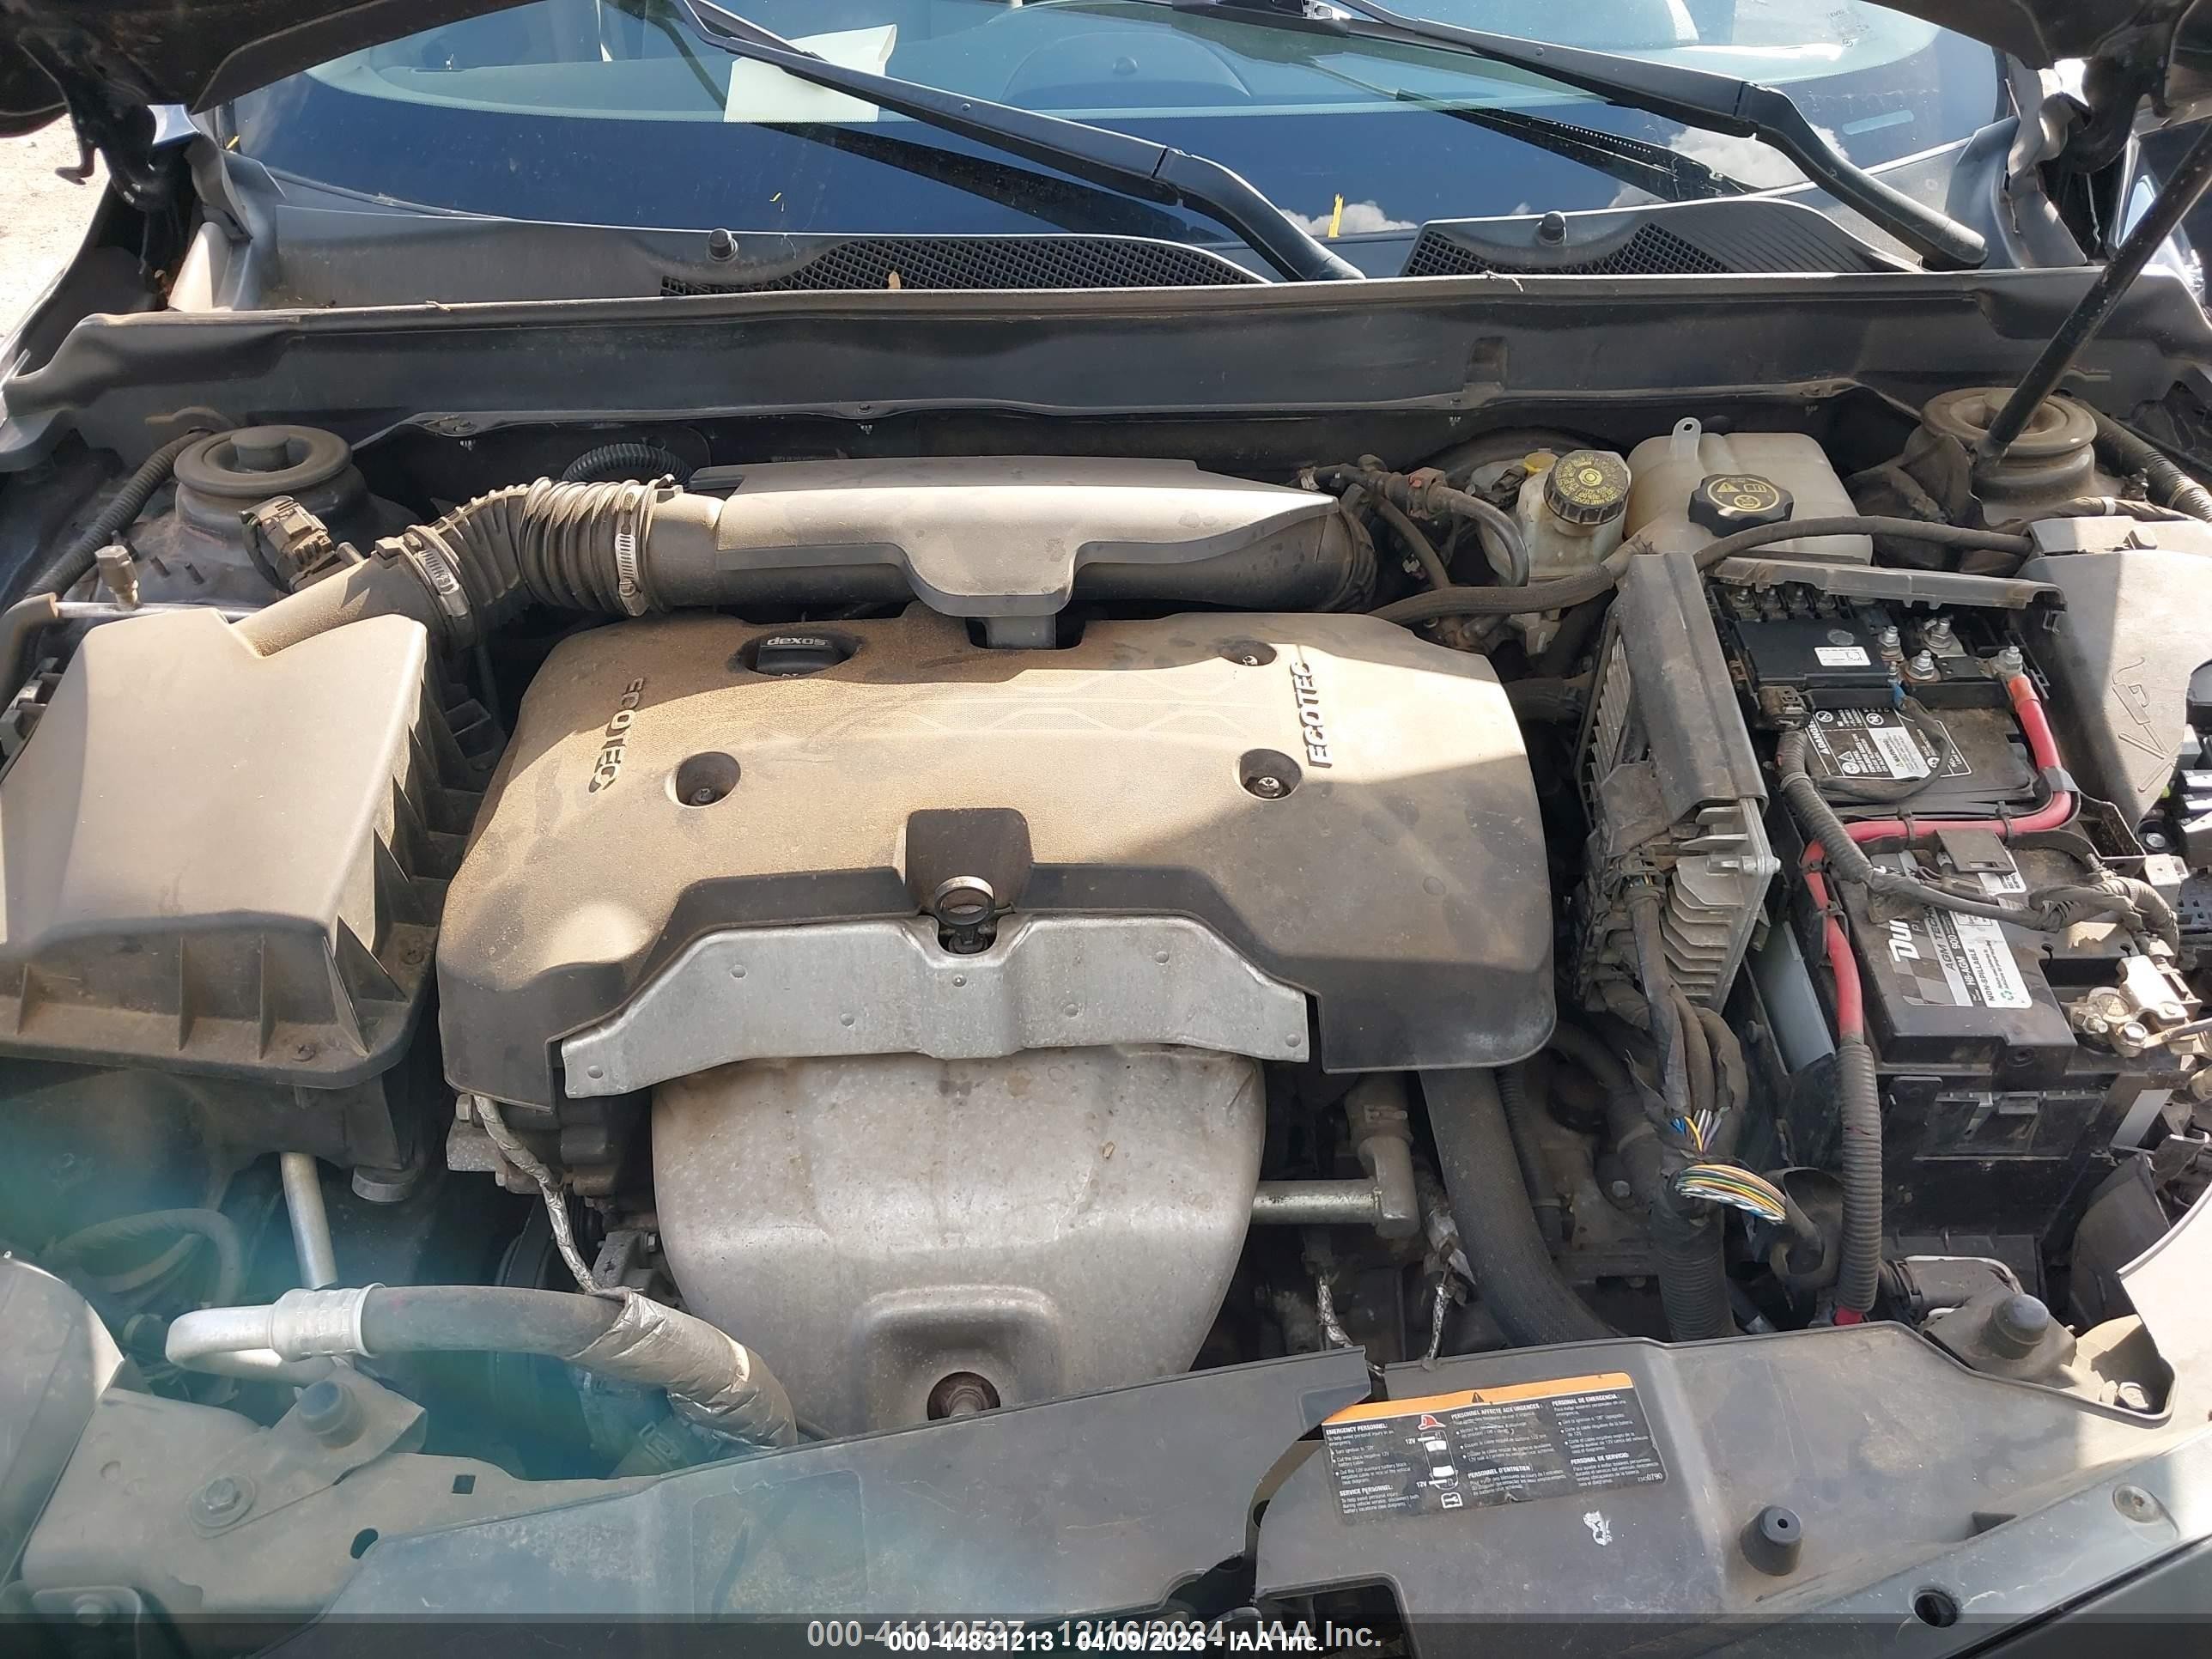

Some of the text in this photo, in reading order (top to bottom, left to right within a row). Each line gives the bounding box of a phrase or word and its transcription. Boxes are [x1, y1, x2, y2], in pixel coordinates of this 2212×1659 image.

[766, 636, 829, 647] dexos
[1290, 660, 1333, 769] ECOTEC
[589, 677, 645, 794] ECOTEC
[1808, 719, 1827, 749] DANGE
[1948, 934, 1960, 950] 900
[1936, 943, 1957, 972] AGM
[1968, 948, 1996, 1001] NON-SPILLABLE
[1339, 1488, 1361, 1497] SERVICE
